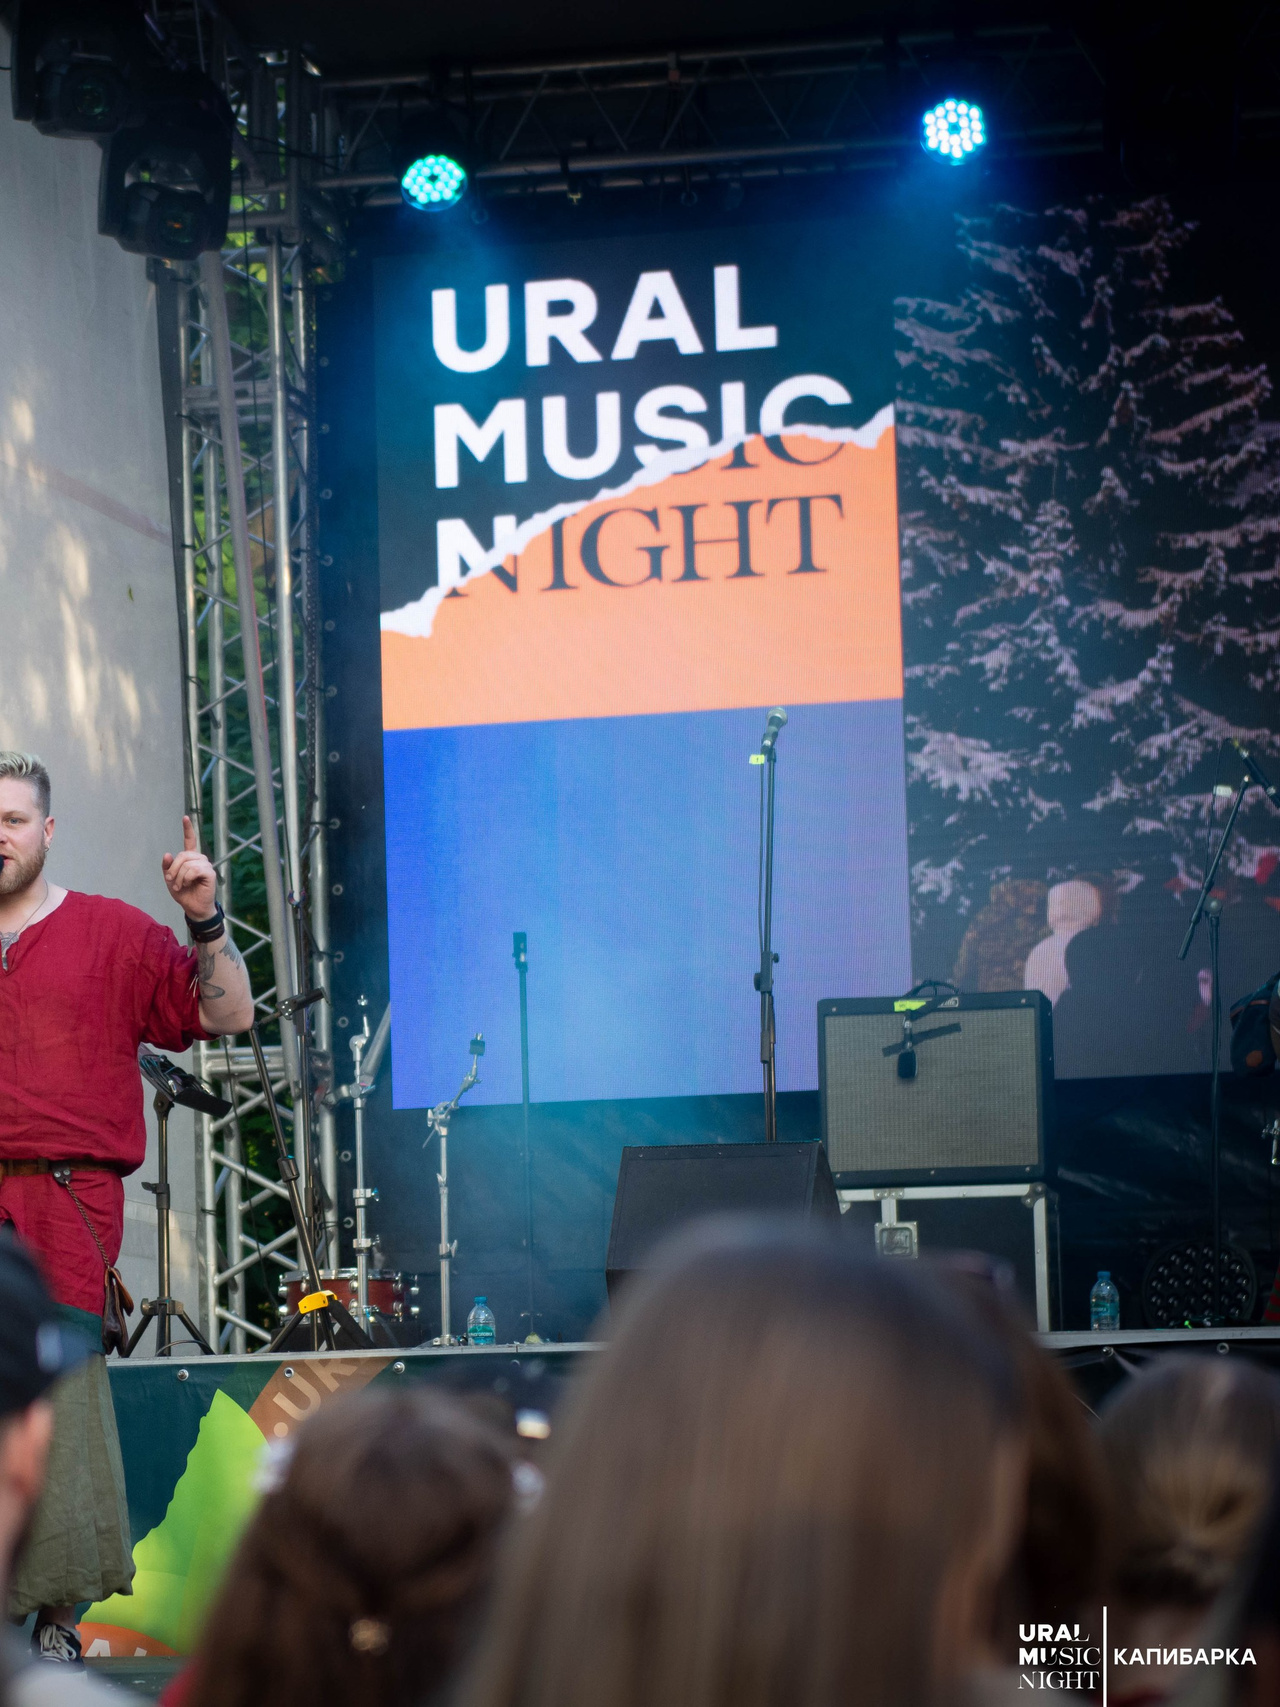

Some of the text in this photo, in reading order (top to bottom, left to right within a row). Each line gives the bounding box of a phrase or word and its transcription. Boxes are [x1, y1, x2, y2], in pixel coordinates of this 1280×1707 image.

[431, 265, 778, 374] URAL
[434, 374, 852, 489] MUSIC
[436, 494, 844, 599] NIGHT
